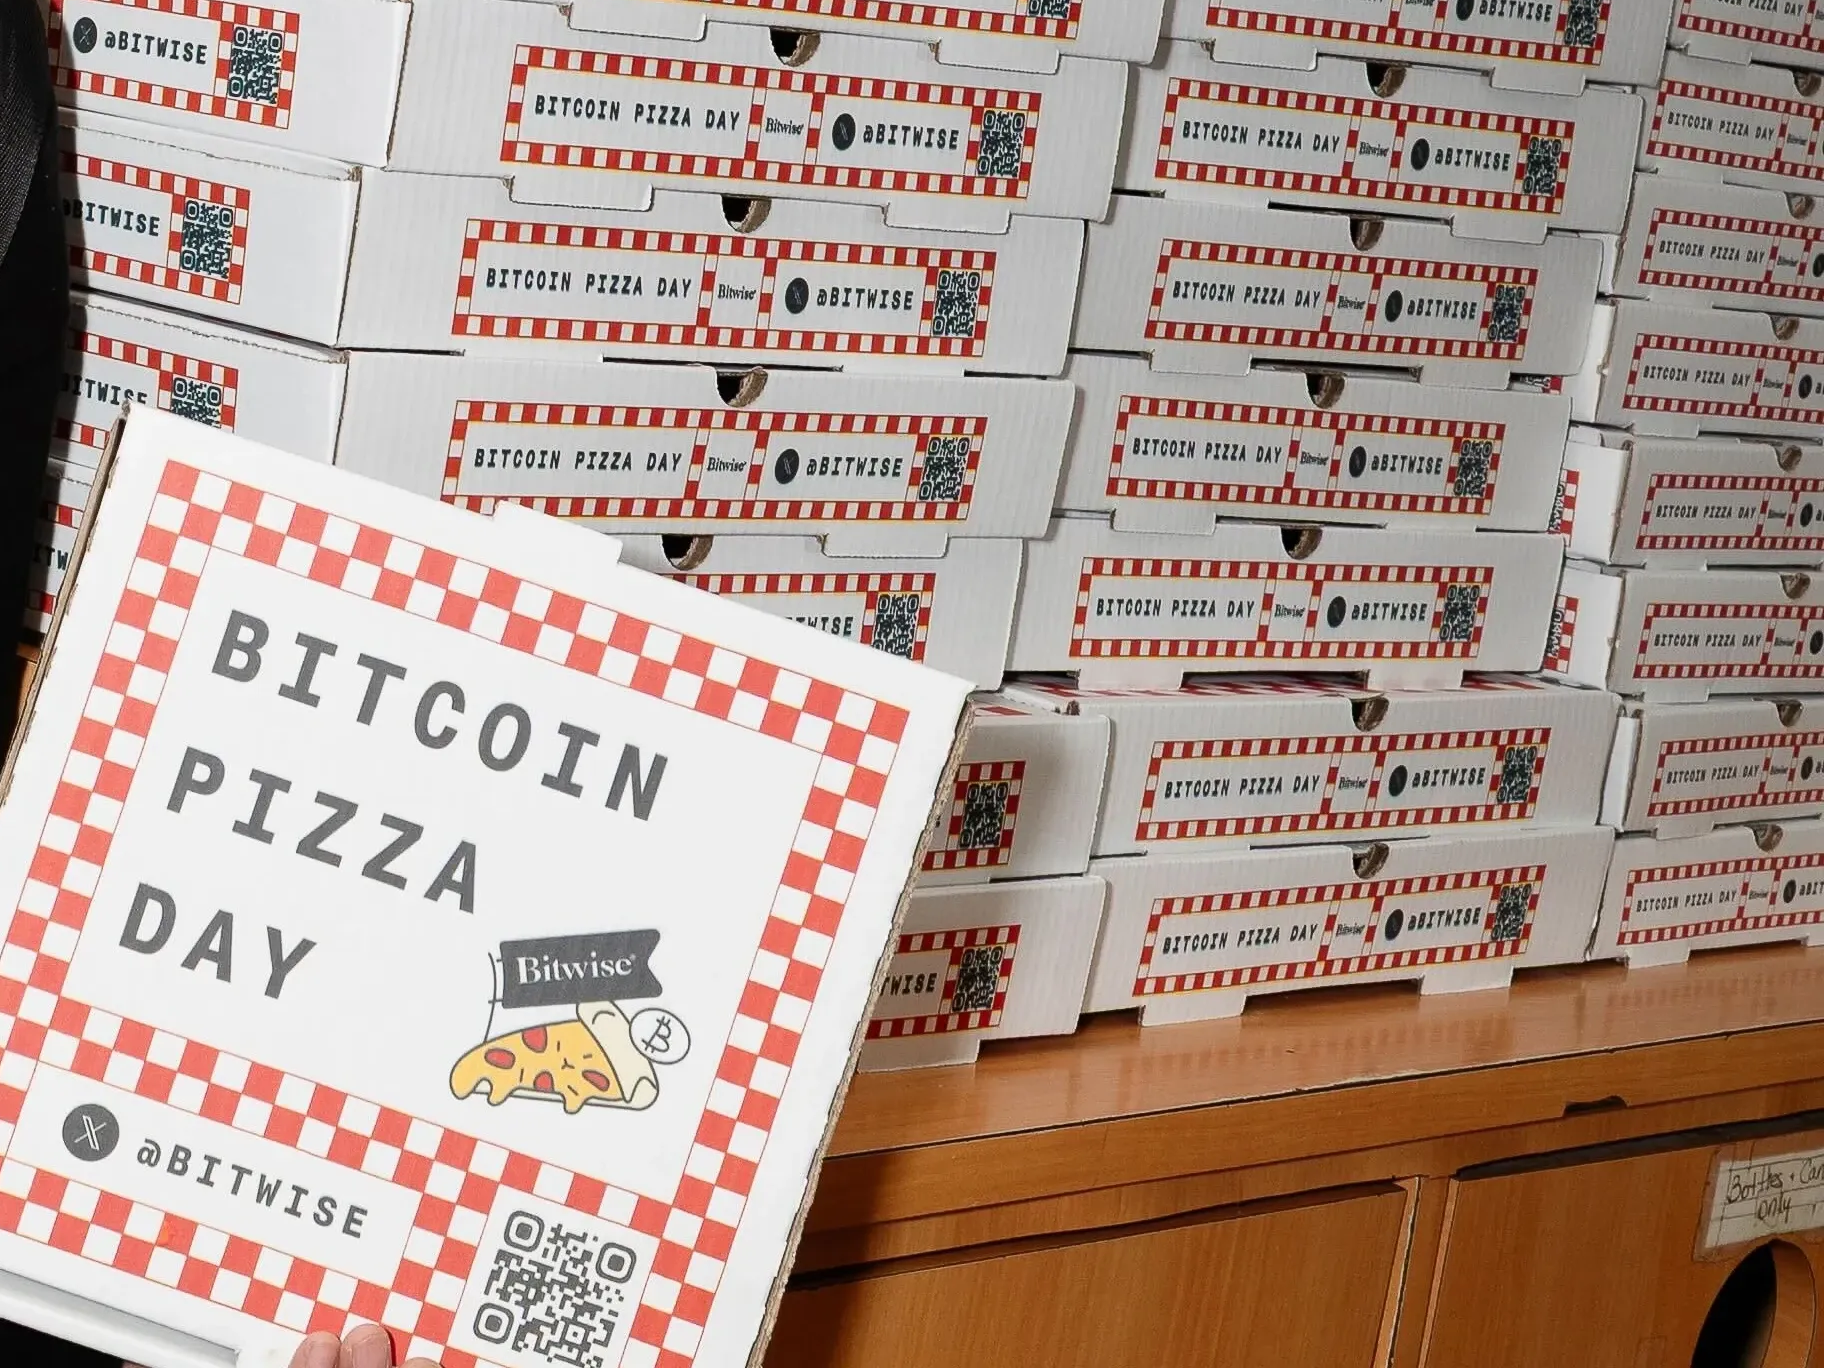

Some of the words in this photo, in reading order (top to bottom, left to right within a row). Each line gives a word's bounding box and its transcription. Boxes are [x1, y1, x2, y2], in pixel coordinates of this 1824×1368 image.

[104, 30, 208, 65] @BITWISE
[534, 94, 621, 121] BITCOIN
[634, 103, 691, 128] PIZZA
[705, 109, 740, 131] DAY
[765, 117, 805, 136] Bitwise
[1182, 120, 1249, 145] BITCOIN
[1257, 128, 1302, 150] PIZZA
[1312, 133, 1340, 154] DAY
[486, 267, 572, 292] BITCOIN
[585, 273, 643, 296] PIZZA
[657, 277, 694, 300] DAY
[717, 283, 757, 301] Bitwise
[474, 448, 561, 470] BITCOIN
[574, 450, 632, 471] PIZZA
[646, 452, 682, 472] DAY
[706, 456, 748, 473] Bitwise
[1132, 437, 1196, 459] BITCOIN
[1204, 442, 1246, 462] PIZZA
[1255, 445, 1282, 464] DAY
[210, 608, 669, 822] BITCOIN
[165, 745, 477, 915] PIZZA
[118, 881, 318, 1000] DAY
[1162, 932, 1229, 955] BITCOIN
[1237, 926, 1281, 948] PIZZA
[1289, 923, 1318, 942] DAY
[516, 950, 633, 985] Bitwise
[135, 1138, 369, 1240] @BITWISE
